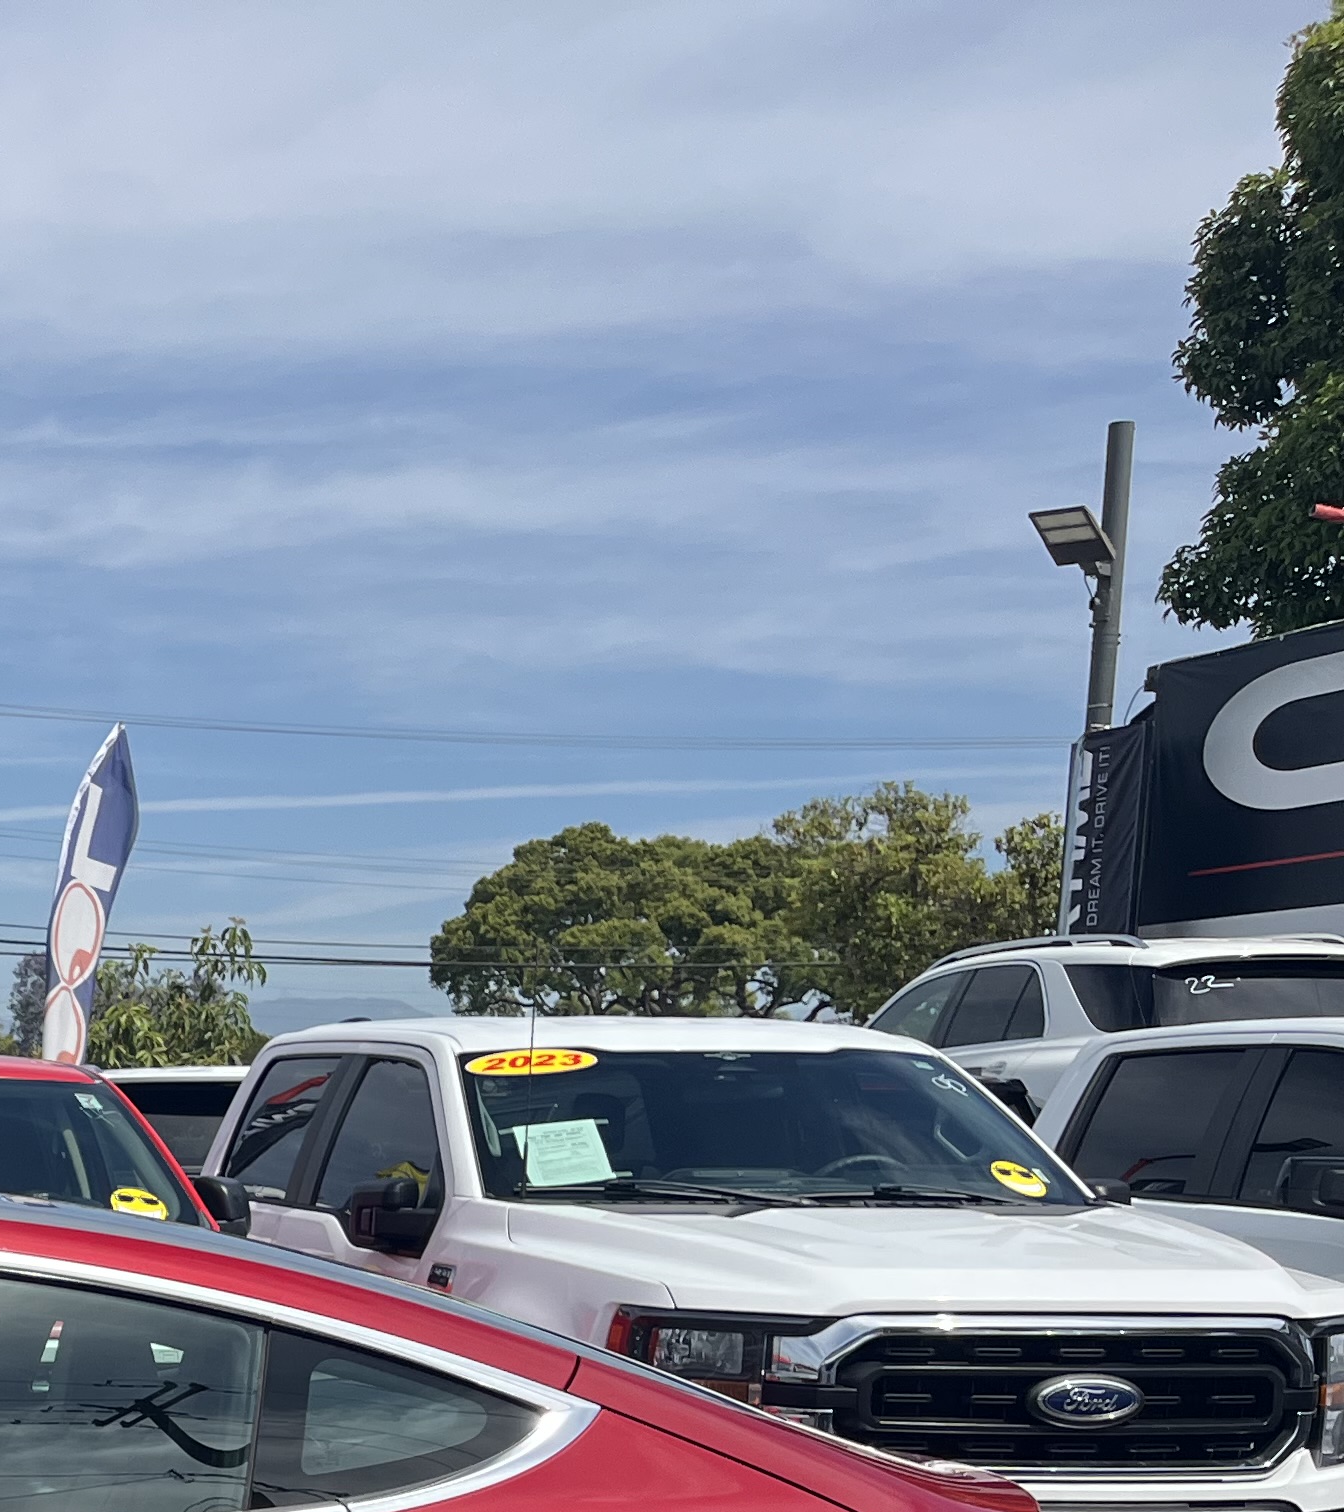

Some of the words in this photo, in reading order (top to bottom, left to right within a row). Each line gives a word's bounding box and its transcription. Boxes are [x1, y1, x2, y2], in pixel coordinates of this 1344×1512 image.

[1094, 772, 1108, 828] DRIVE
[1086, 858, 1103, 926] DREAM
[482, 1054, 582, 1071] 2023
[1064, 1387, 1118, 1411] Ford
